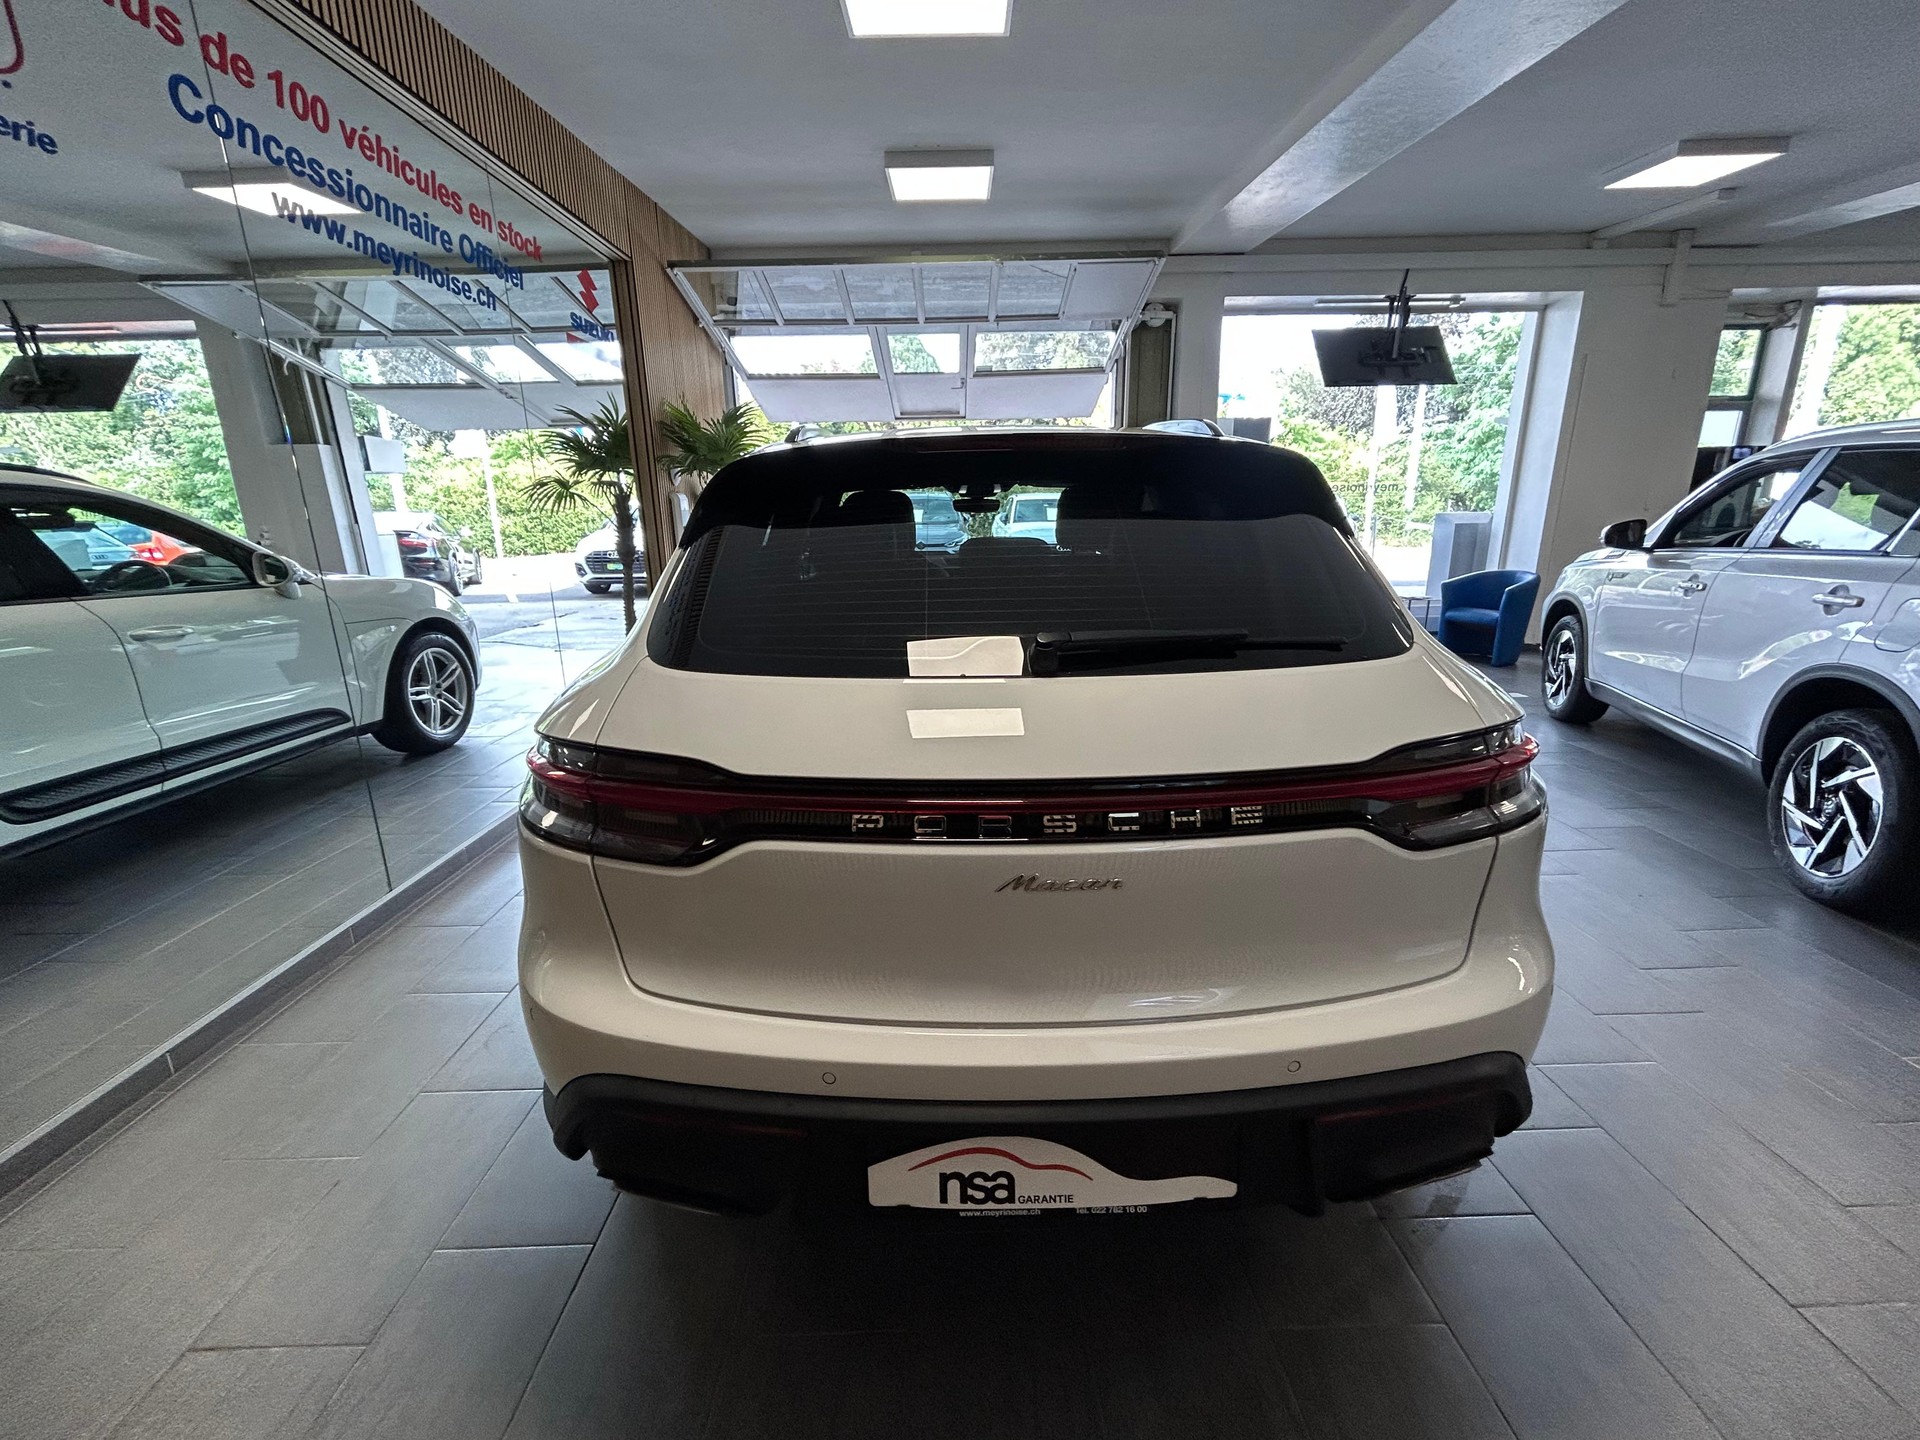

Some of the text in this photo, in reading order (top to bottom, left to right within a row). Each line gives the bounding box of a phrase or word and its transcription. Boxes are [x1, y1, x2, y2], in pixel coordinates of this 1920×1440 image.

[102, 0, 543, 263] us de 100 véhicules en stock
[168, 73, 524, 291] Concessionnaire Officiel
[271, 191, 497, 311] www.meyrinoise.ch
[569, 311, 615, 342] SUZUKI
[851, 804, 1264, 839] PORSCHE
[994, 872, 1123, 893] Macan
[938, 1169, 1016, 1205] nsa
[1018, 1195, 1074, 1204] GARANTIE
[959, 1208, 1041, 1217] www.meyrinoise.ch
[1136, 1205, 1148, 1213] 00
